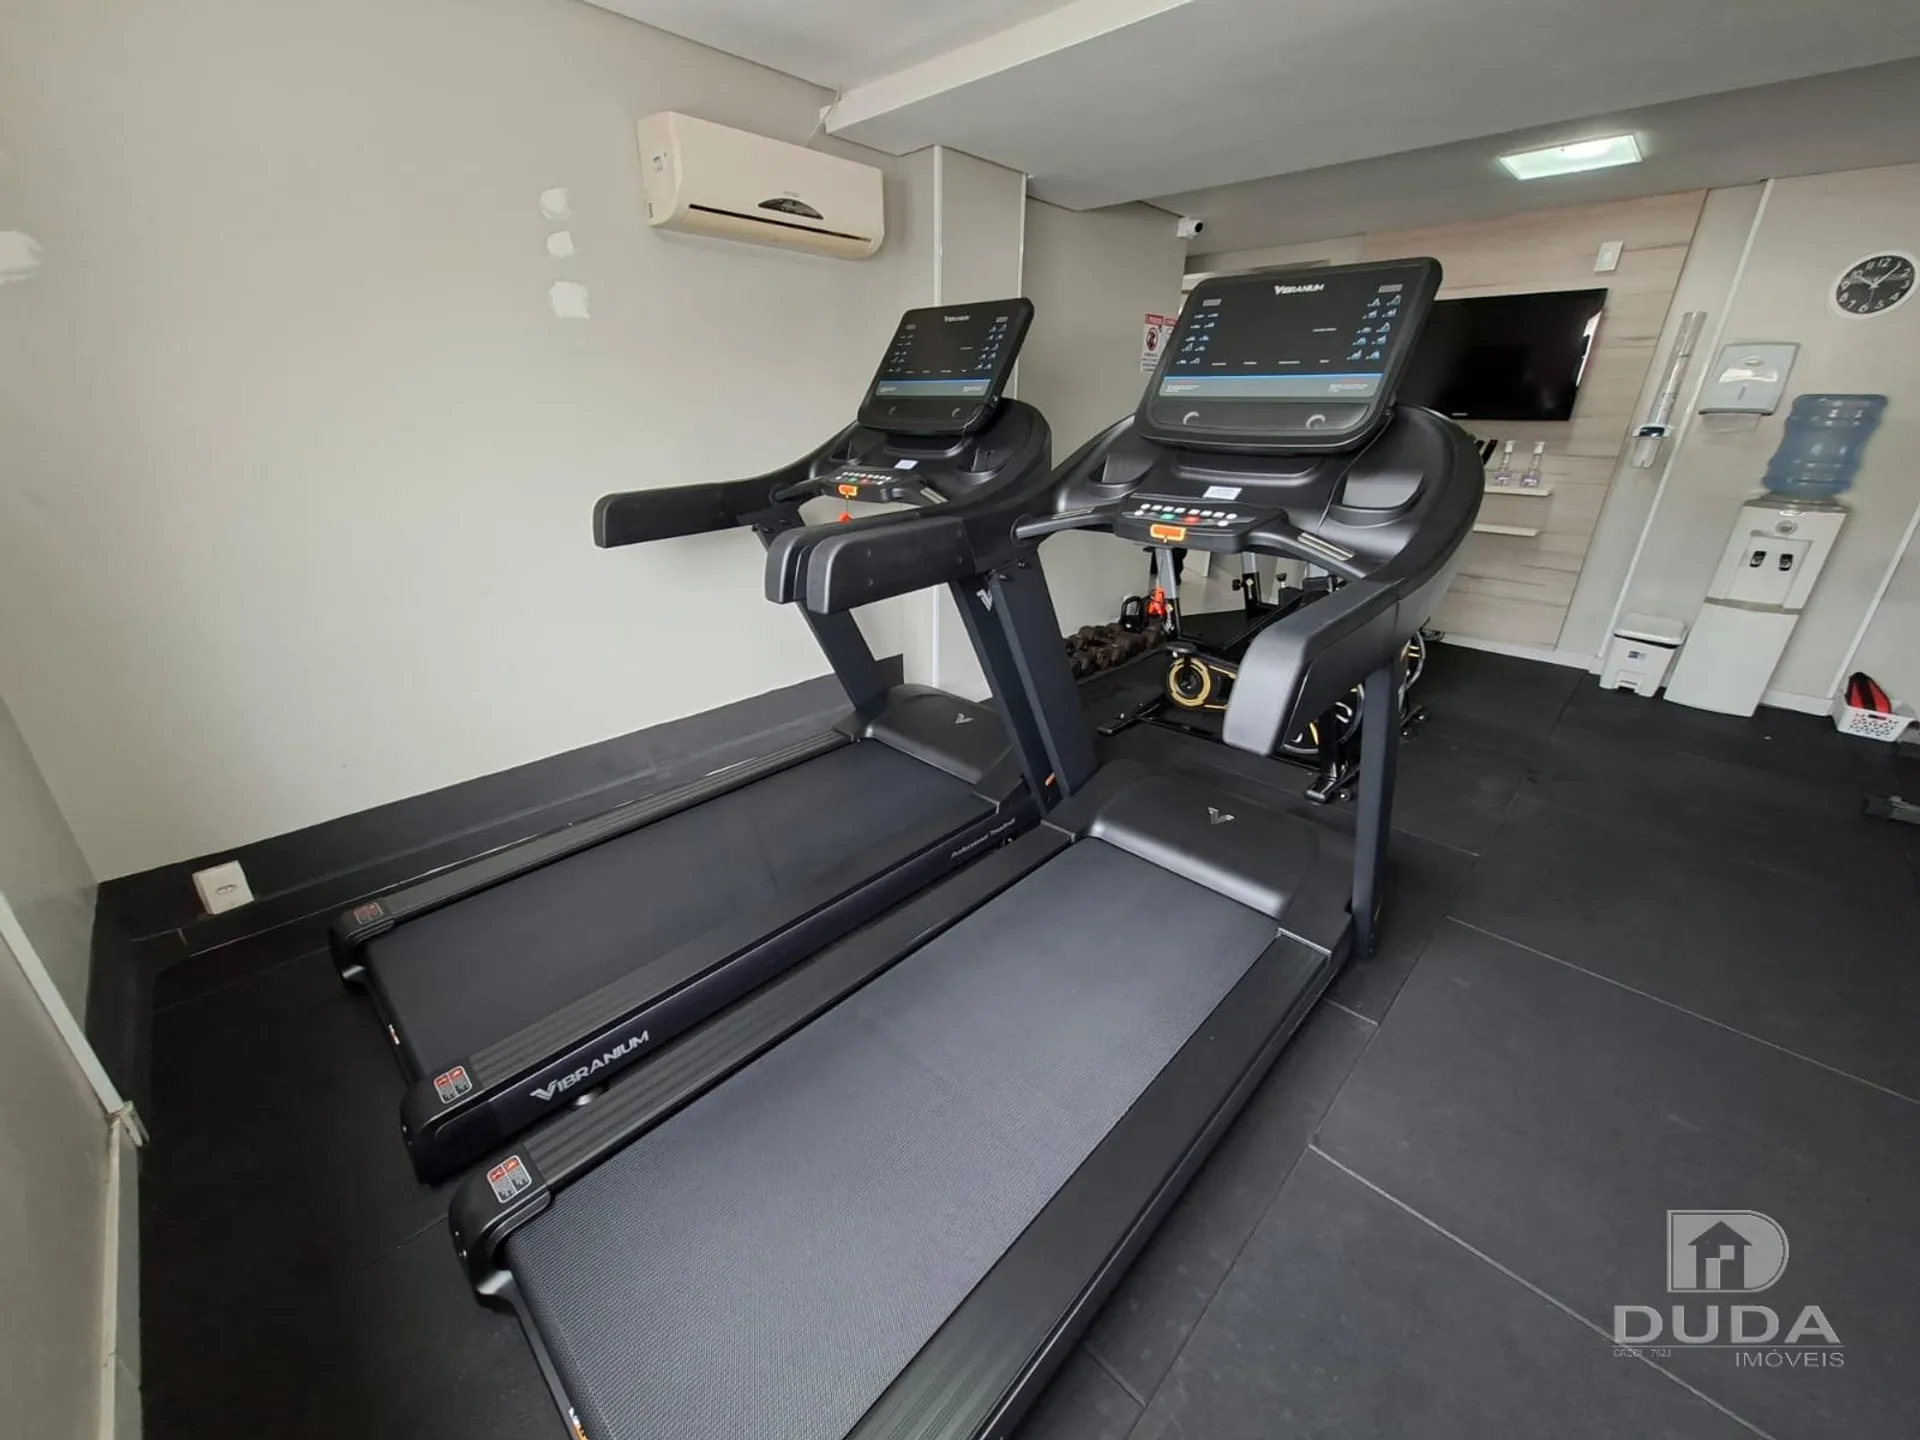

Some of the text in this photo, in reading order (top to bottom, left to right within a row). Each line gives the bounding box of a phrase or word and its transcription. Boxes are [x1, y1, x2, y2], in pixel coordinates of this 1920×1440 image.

[1865, 261, 1875, 271] 11
[1877, 258, 1892, 268] 12
[1851, 269, 1864, 280] 10
[1900, 268, 1911, 278] 2
[1841, 280, 1851, 291] 9
[1900, 280, 1910, 289] 3
[1847, 300, 1857, 309] 7
[1858, 302, 1869, 312] 6
[530, 1030, 649, 1101] VIBRANIUM
